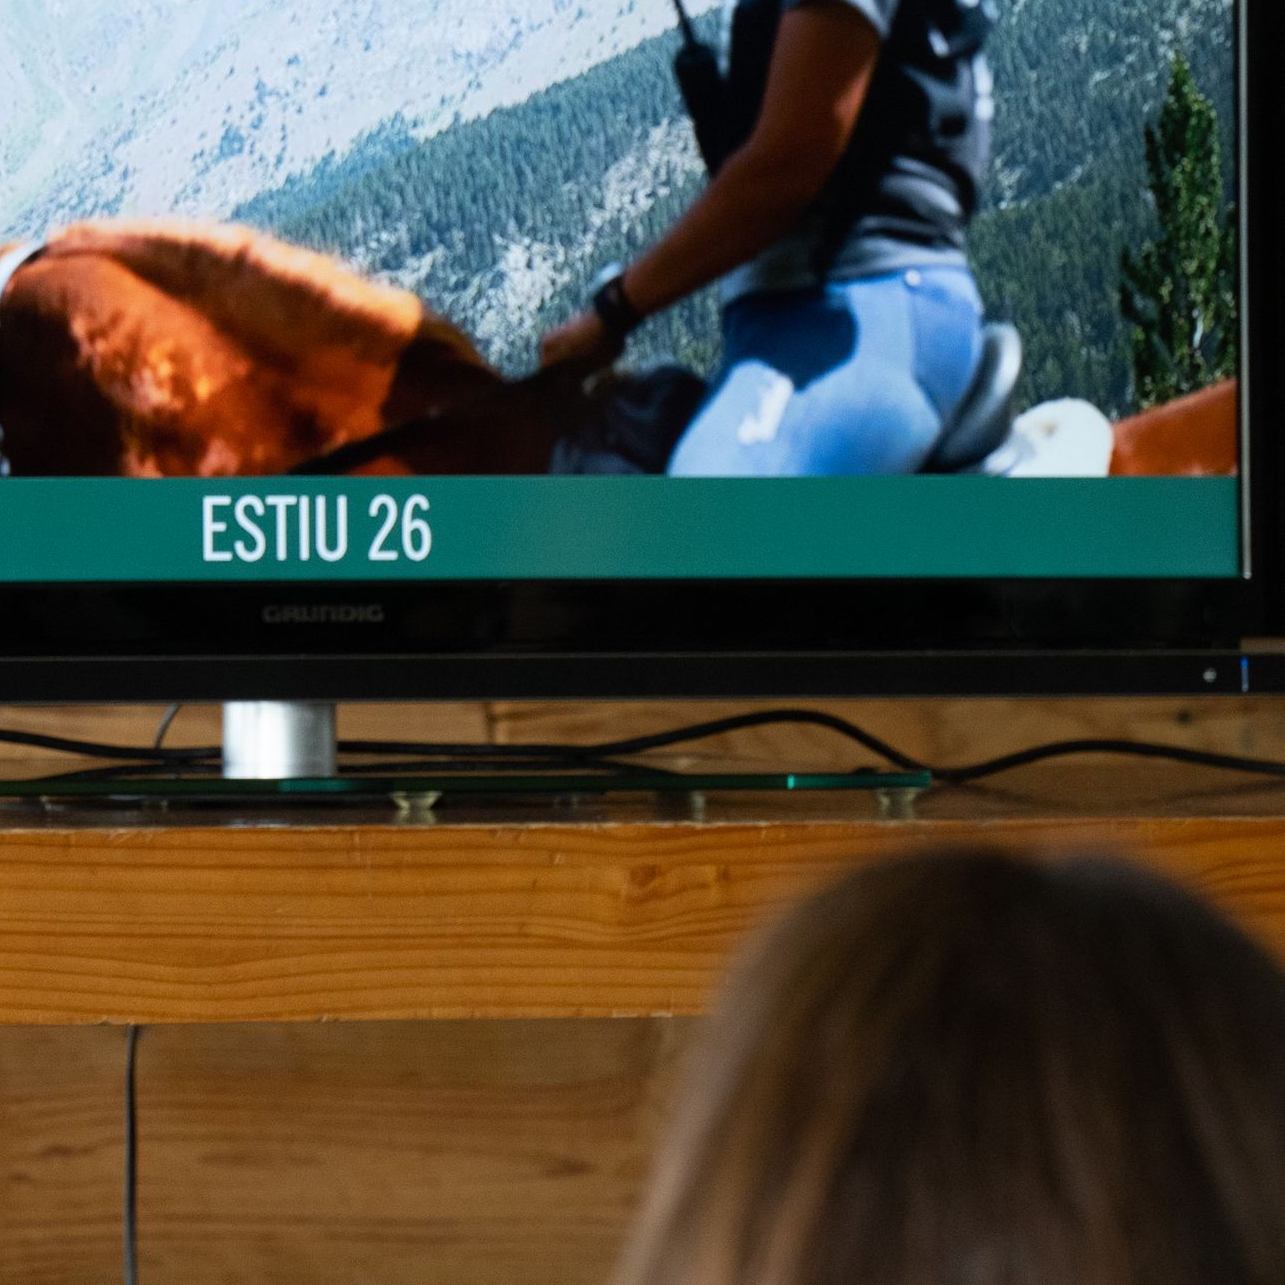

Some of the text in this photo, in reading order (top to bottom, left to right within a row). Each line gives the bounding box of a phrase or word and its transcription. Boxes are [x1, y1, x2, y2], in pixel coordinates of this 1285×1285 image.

[202, 493, 432, 562] ESTIU 26
[262, 604, 385, 623] GRUNDIG
